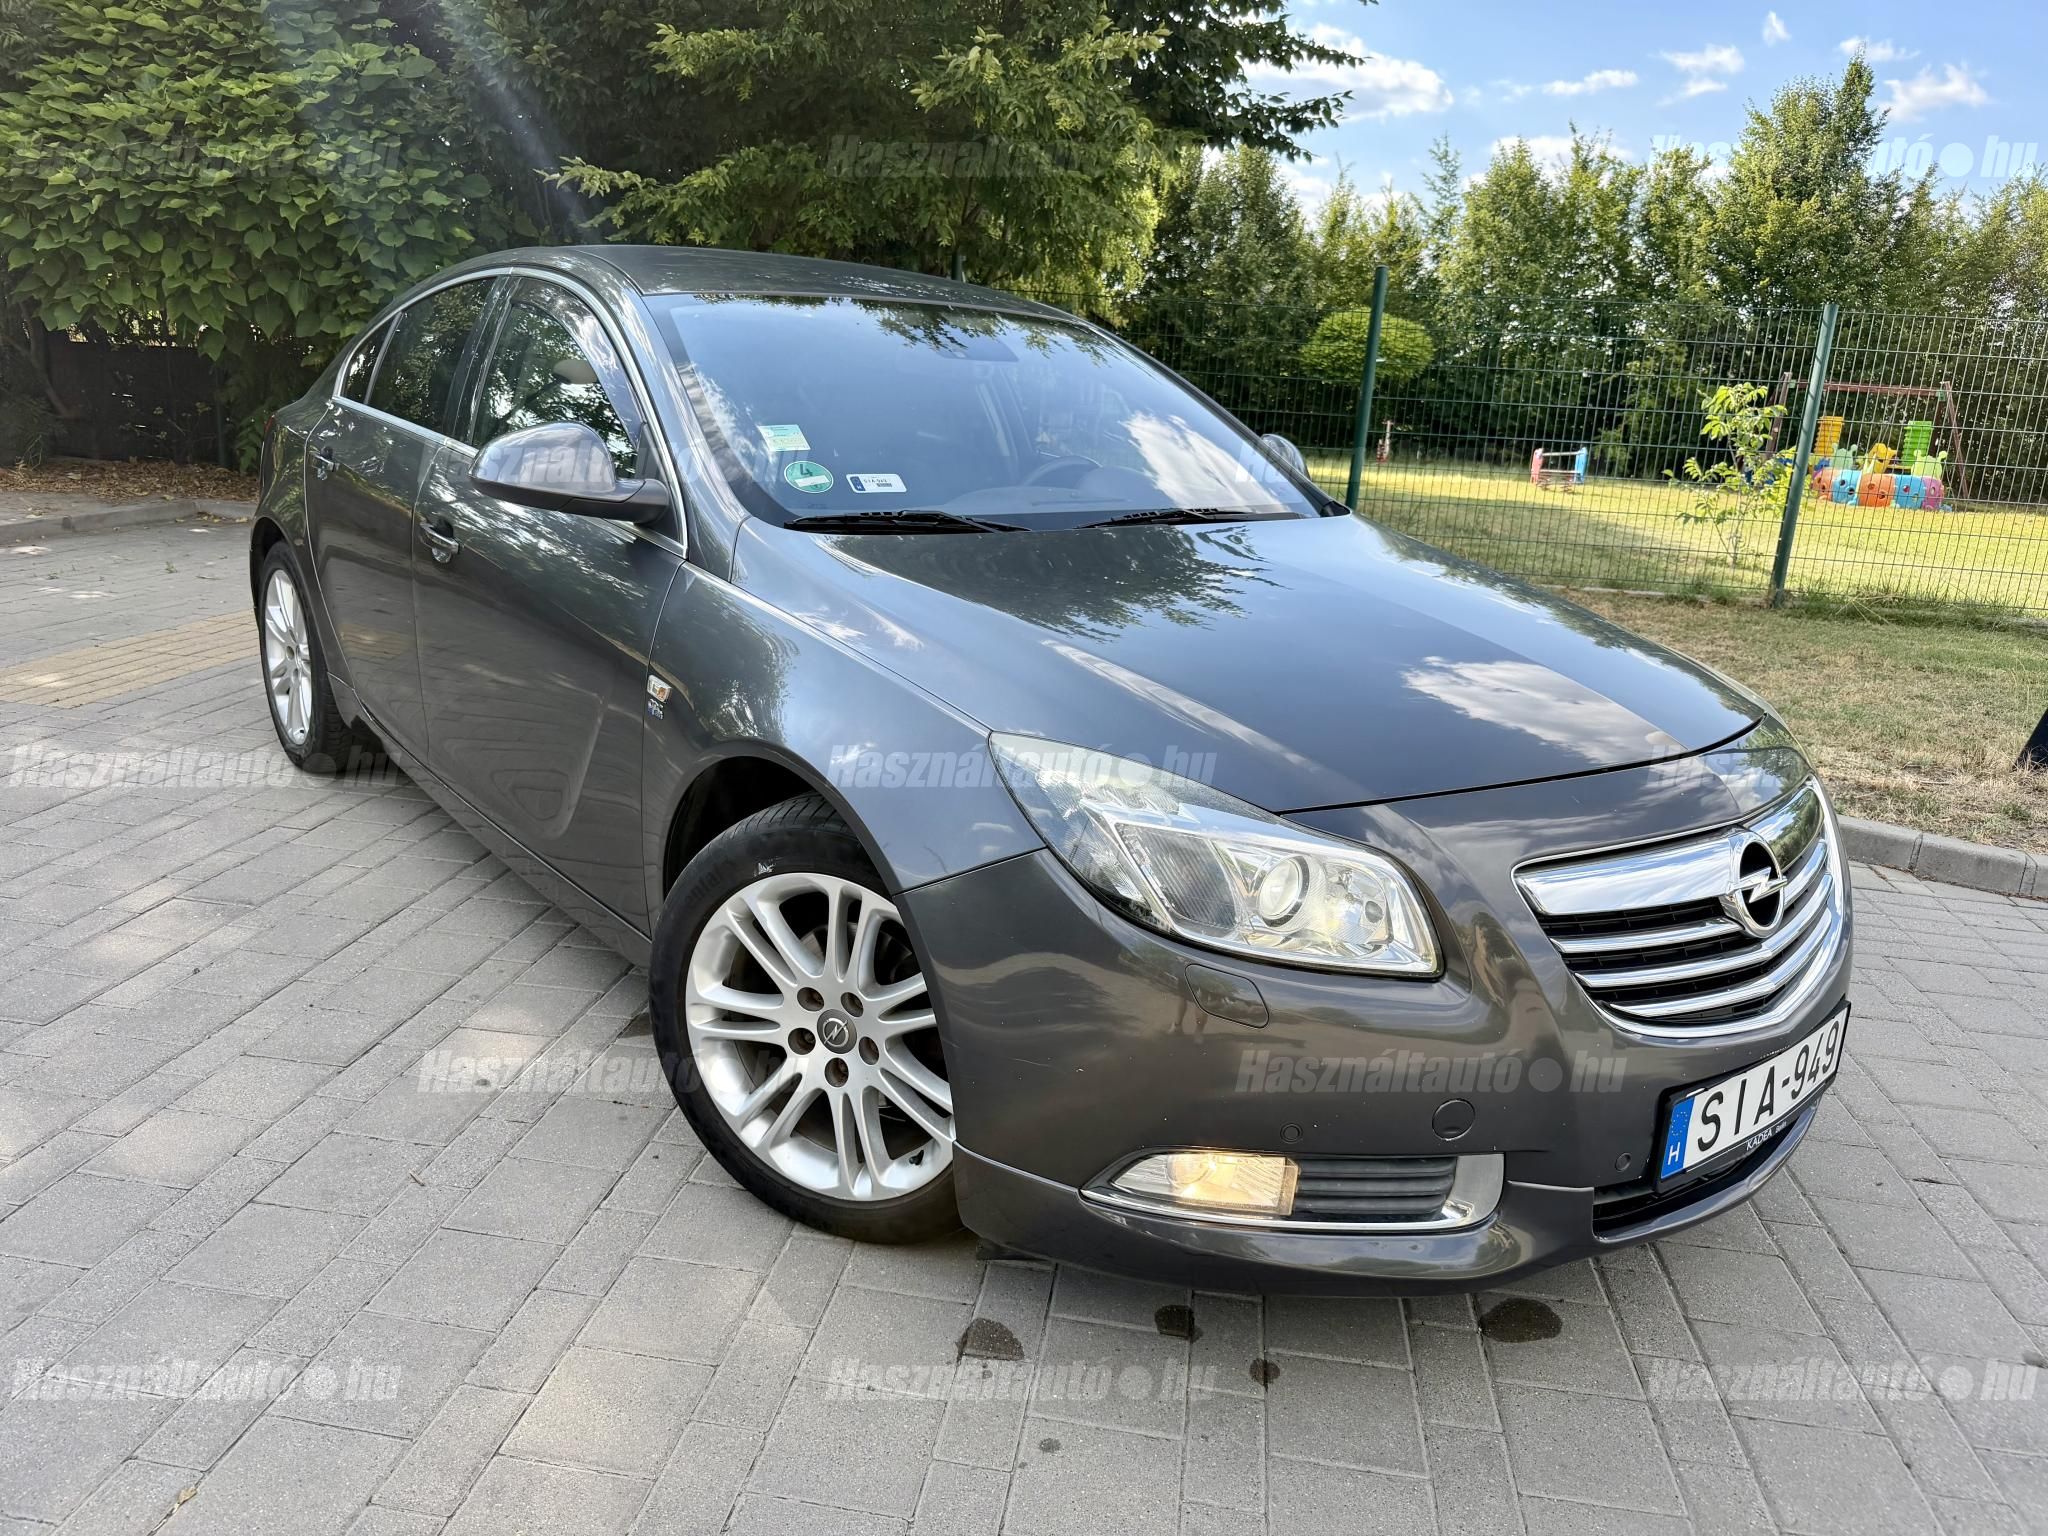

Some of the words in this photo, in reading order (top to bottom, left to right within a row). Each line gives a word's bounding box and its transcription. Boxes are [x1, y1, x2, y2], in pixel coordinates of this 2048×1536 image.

[799, 463, 813, 476] 4
[1697, 1020, 1840, 1152] SIA-949
[1667, 1141, 1681, 1166] H
